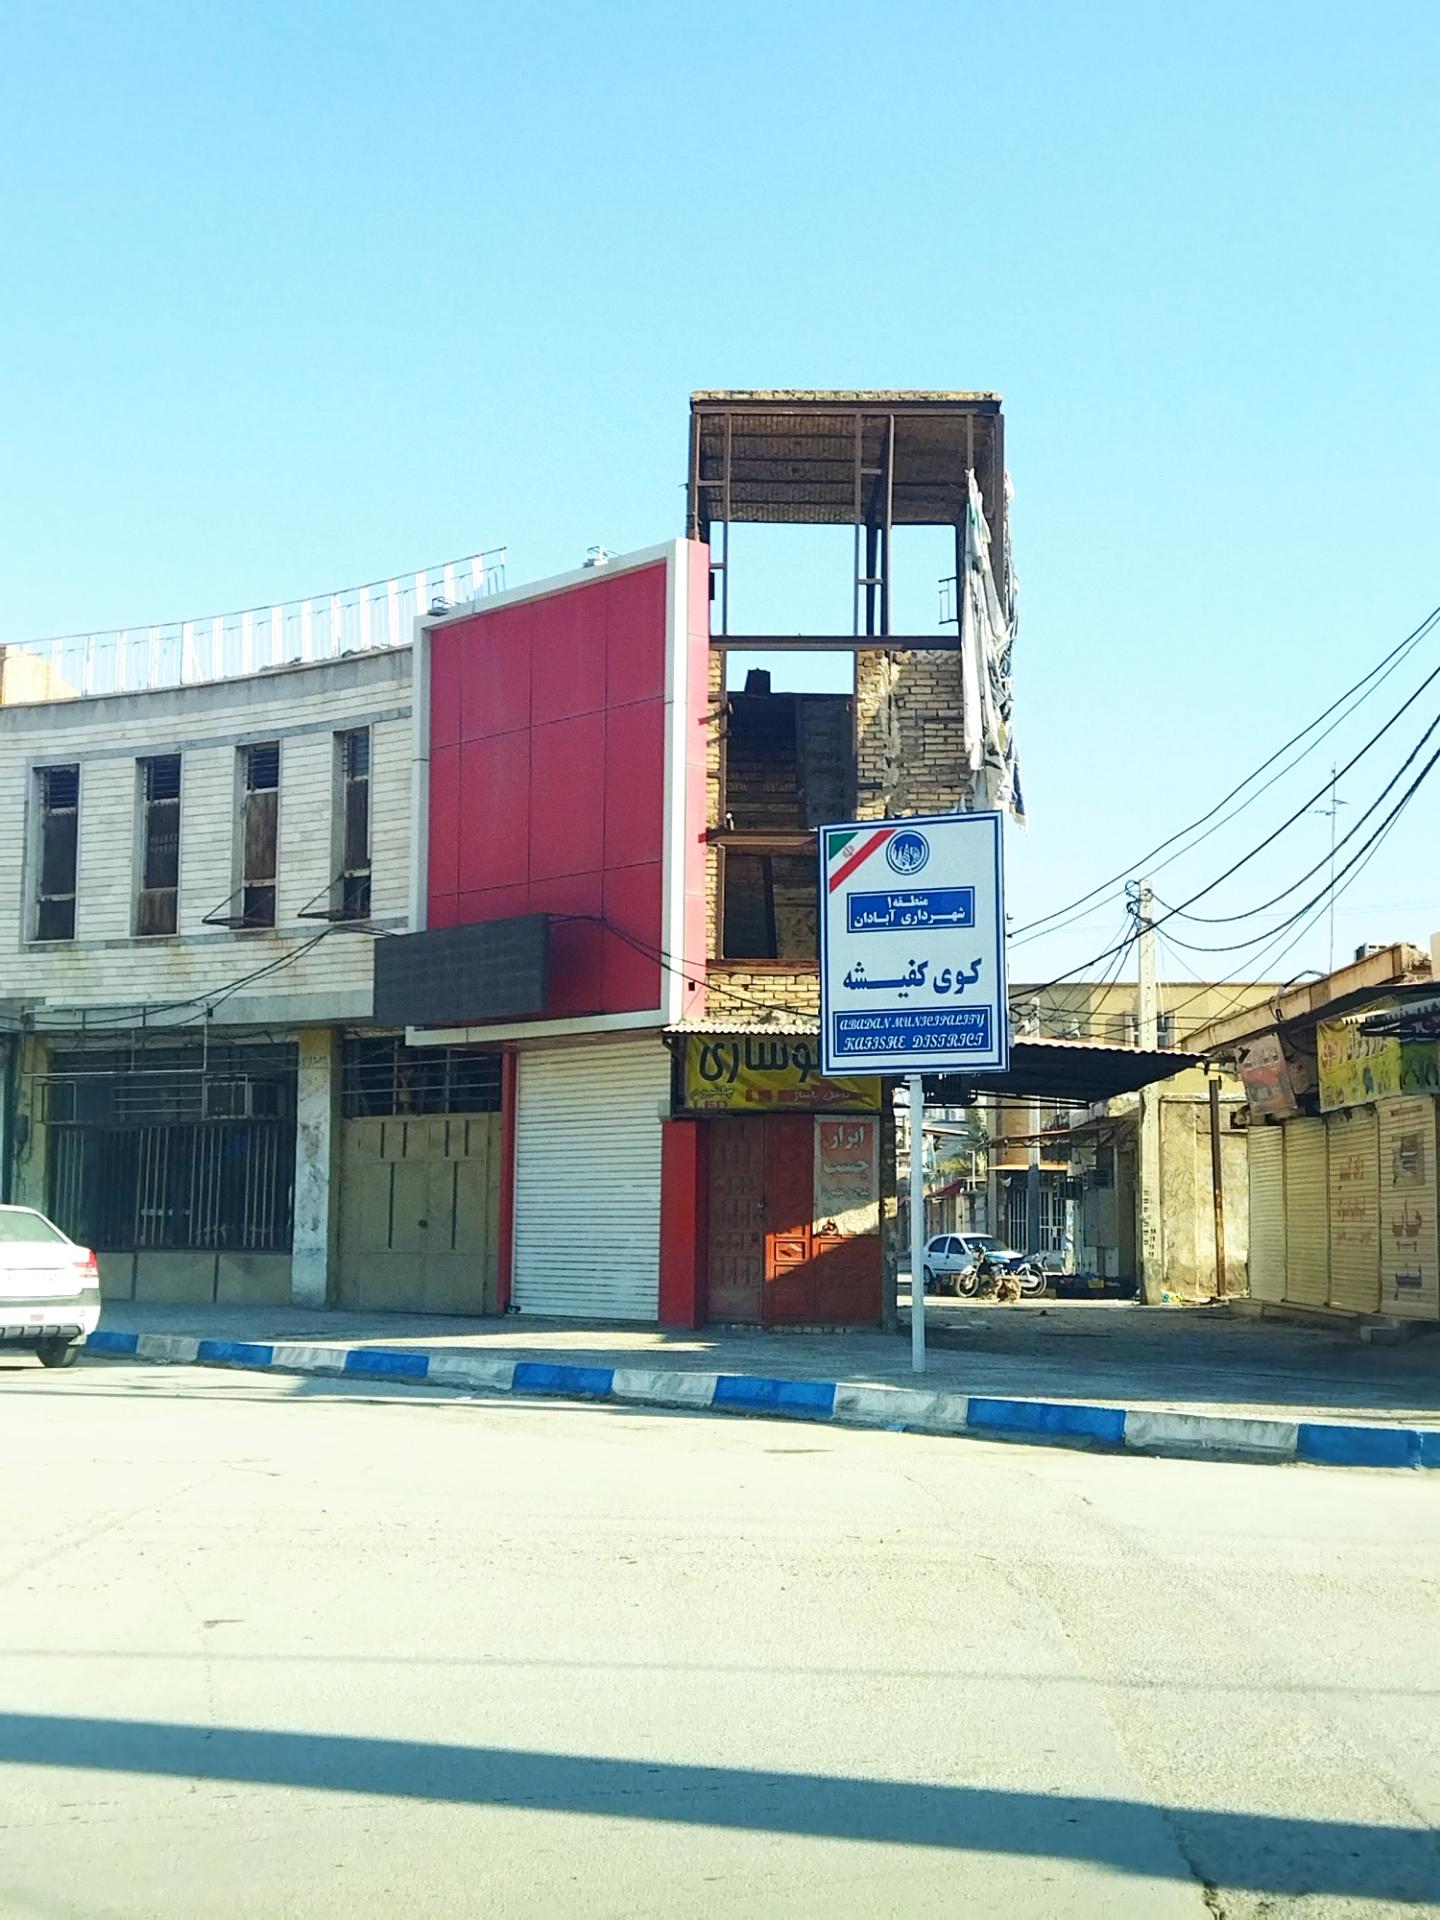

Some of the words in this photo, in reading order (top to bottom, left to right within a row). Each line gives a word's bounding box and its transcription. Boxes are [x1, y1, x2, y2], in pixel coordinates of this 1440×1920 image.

[854, 909, 895, 928] آبادان
[900, 906, 965, 925] شهرداری
[842, 958, 929, 999] کفیشه
[933, 957, 983, 995] کوی
[839, 1017, 891, 1031] ABADAN
[891, 1012, 985, 1029] MUNICIPALITY
[843, 1034, 906, 1051] KAFISHE
[912, 1031, 984, 1048] DISTRICT
[830, 1125, 865, 1150] ابزار
